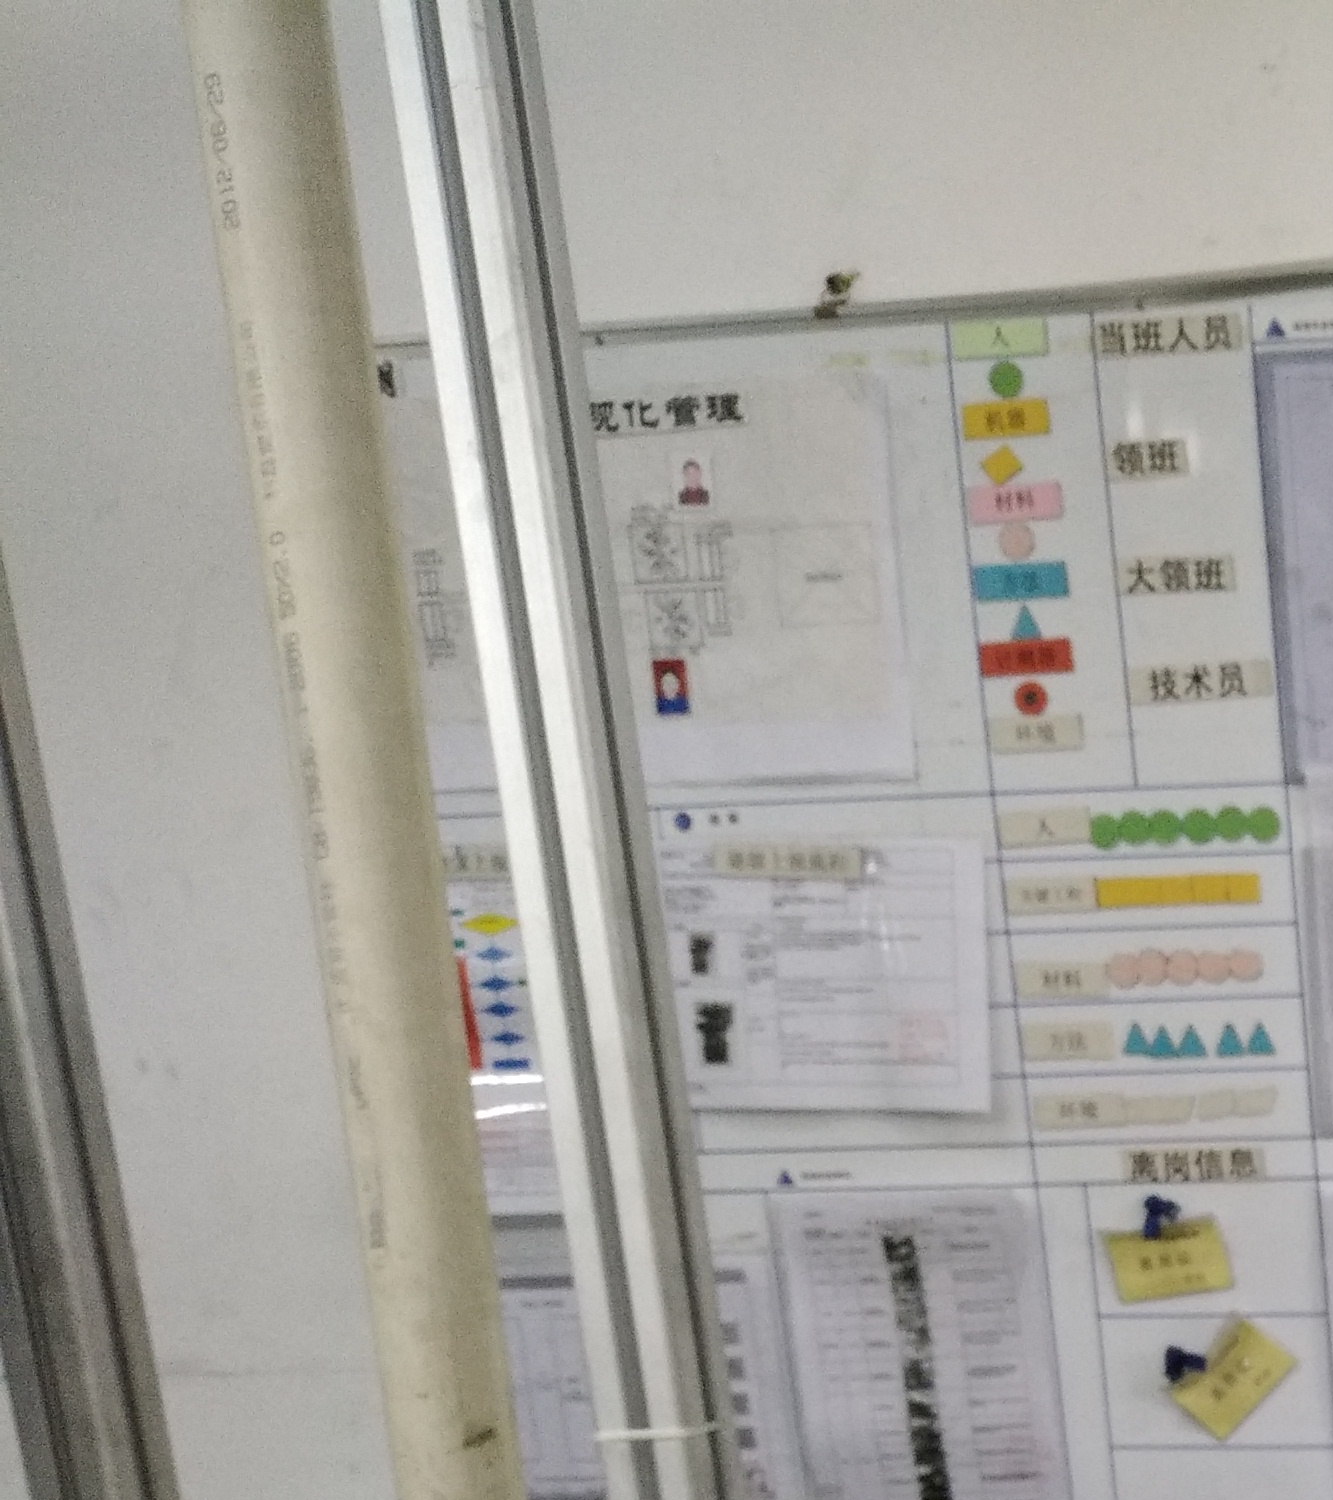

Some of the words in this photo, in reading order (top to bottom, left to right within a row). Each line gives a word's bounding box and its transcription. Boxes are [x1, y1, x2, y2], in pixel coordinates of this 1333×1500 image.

[992, 327, 1007, 348] 人
[1099, 314, 1233, 355] 当班人员
[1112, 439, 1179, 475] 领班
[994, 490, 1034, 511] 材料
[1127, 557, 1226, 594] 大领班
[1150, 662, 1247, 701] 技术员
[1129, 1147, 1257, 1183] 离岗信息
